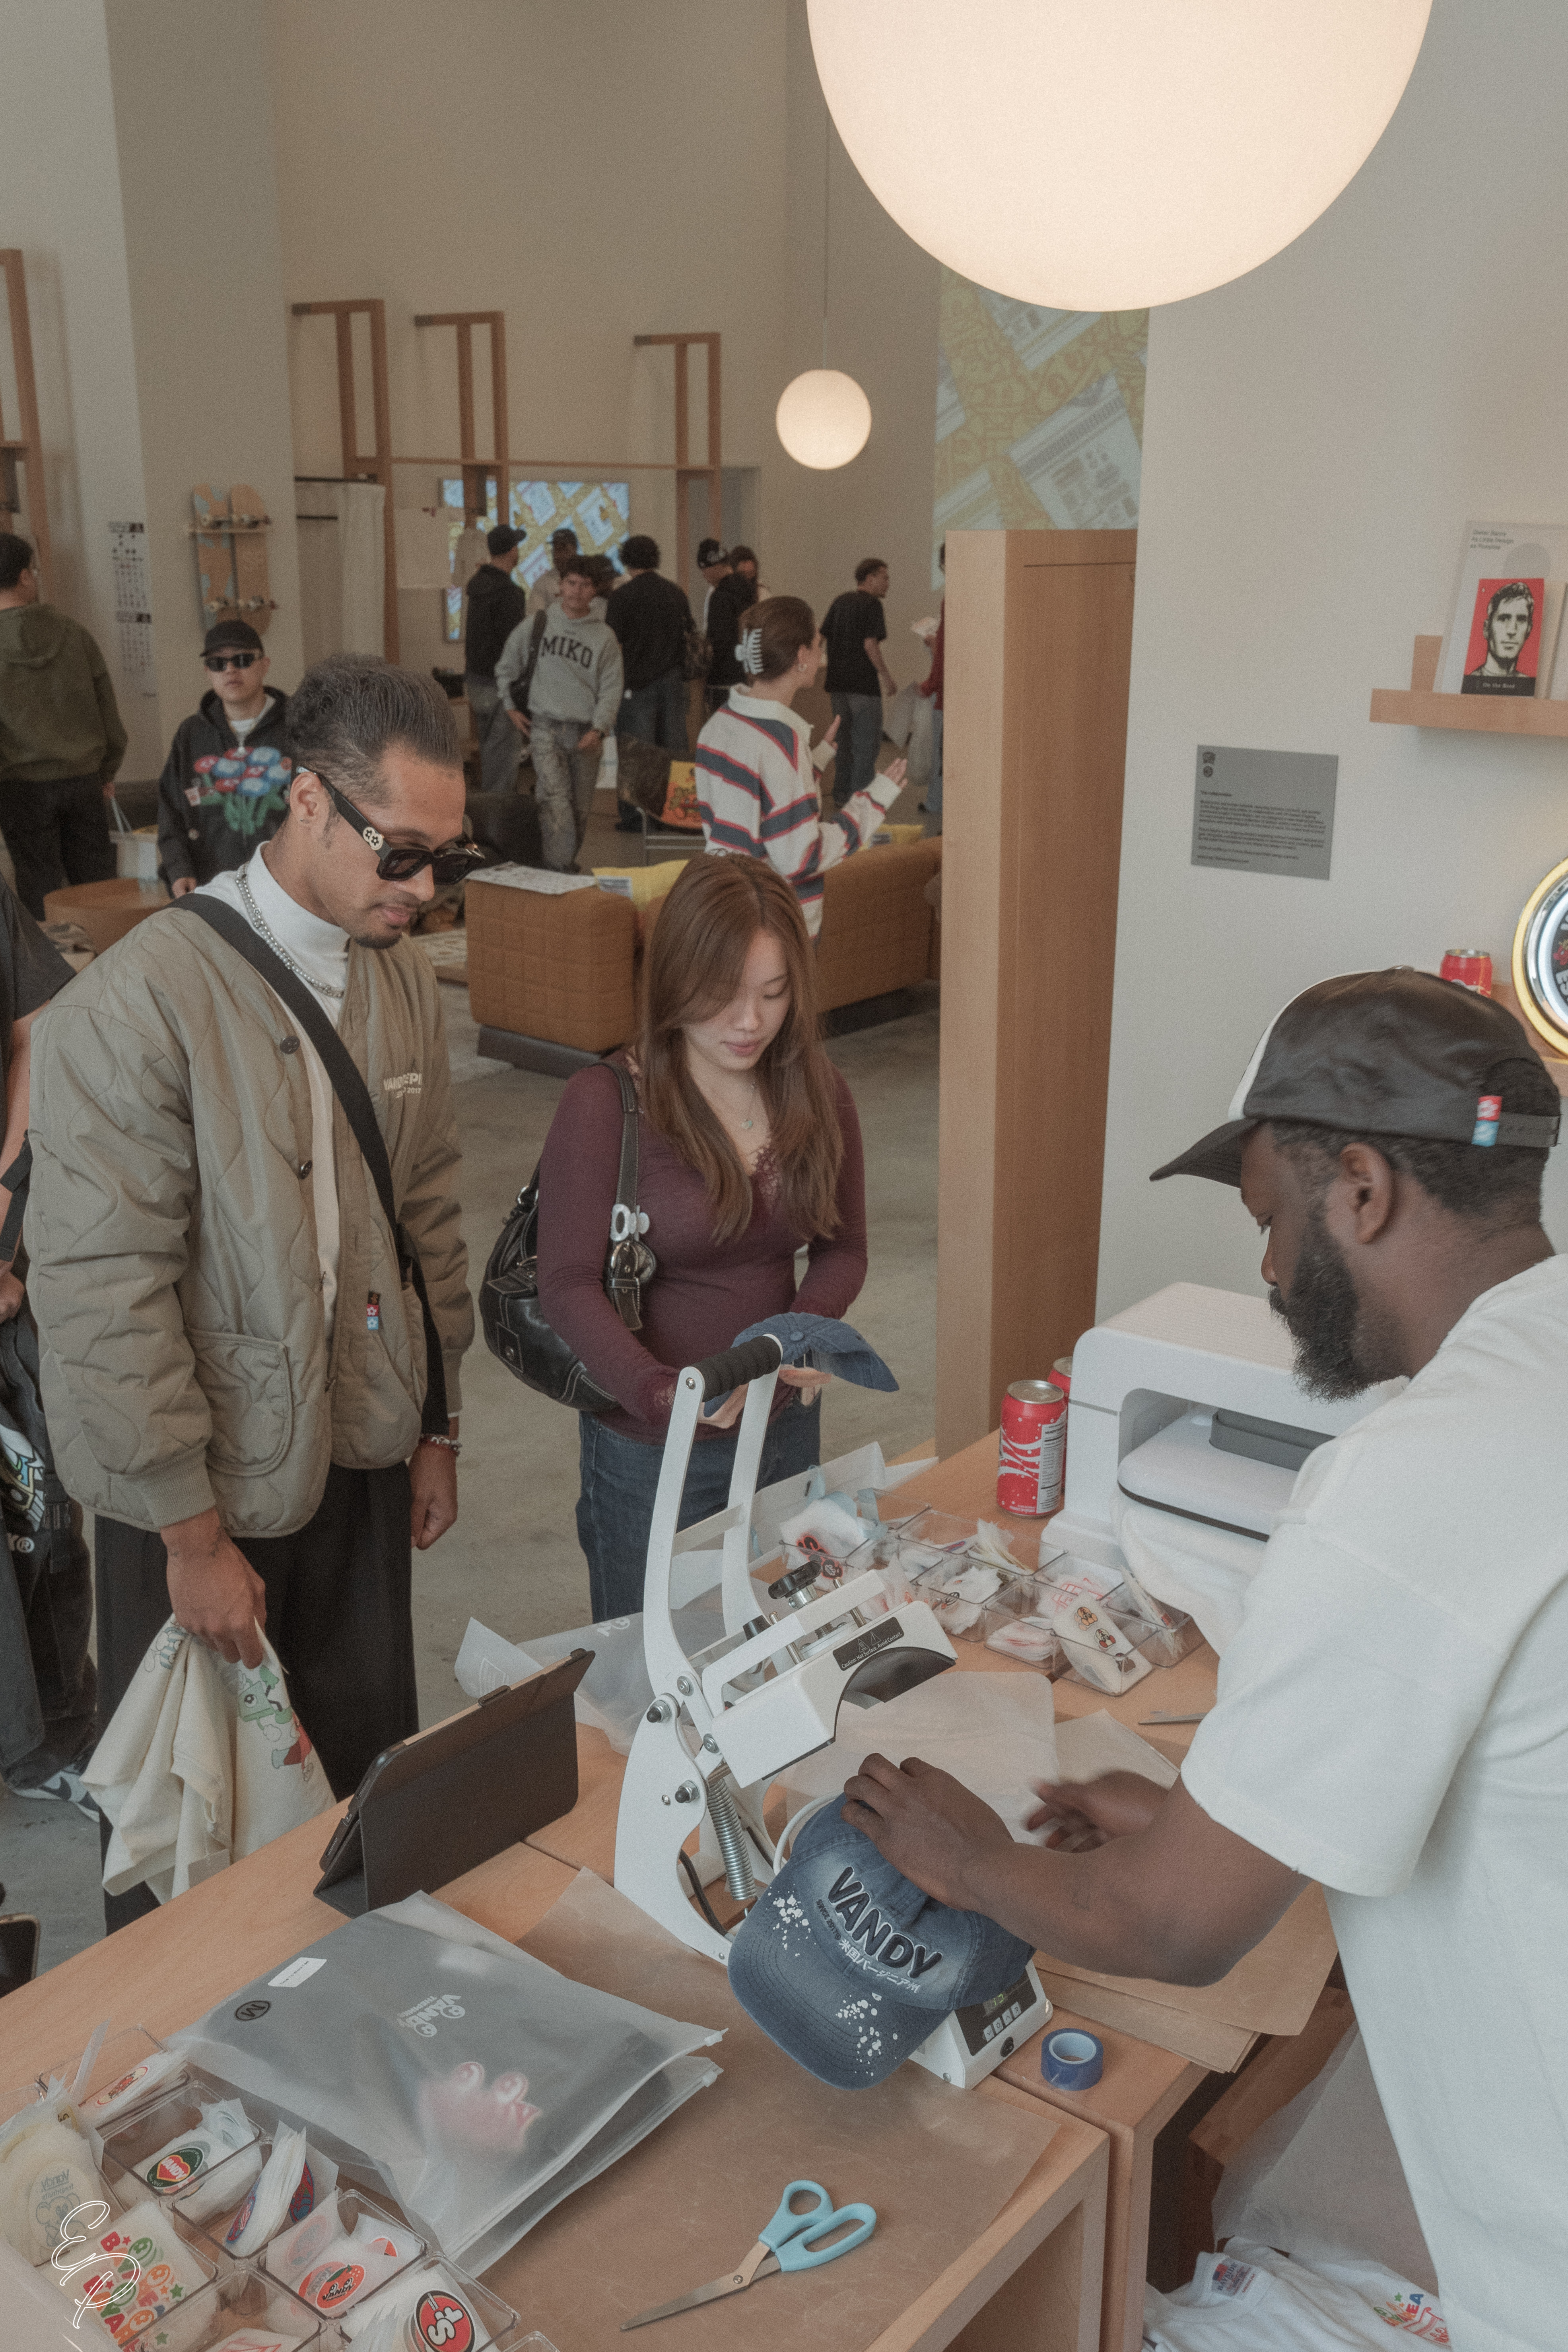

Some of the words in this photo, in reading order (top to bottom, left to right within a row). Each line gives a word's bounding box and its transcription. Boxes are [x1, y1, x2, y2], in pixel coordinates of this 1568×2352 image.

[541, 635, 593, 669] MIKO
[841, 1658, 857, 1669] Caution:
[878, 1639, 888, 1648] Avoid
[887, 1632, 902, 1643] Contact.
[816, 1899, 830, 1920] SINCE
[828, 1866, 942, 1978] VANDY
[839, 1938, 921, 1993] 米国バージニア州
[397, 1994, 465, 2037] VANDY
[161, 2157, 187, 2179] VANDY
